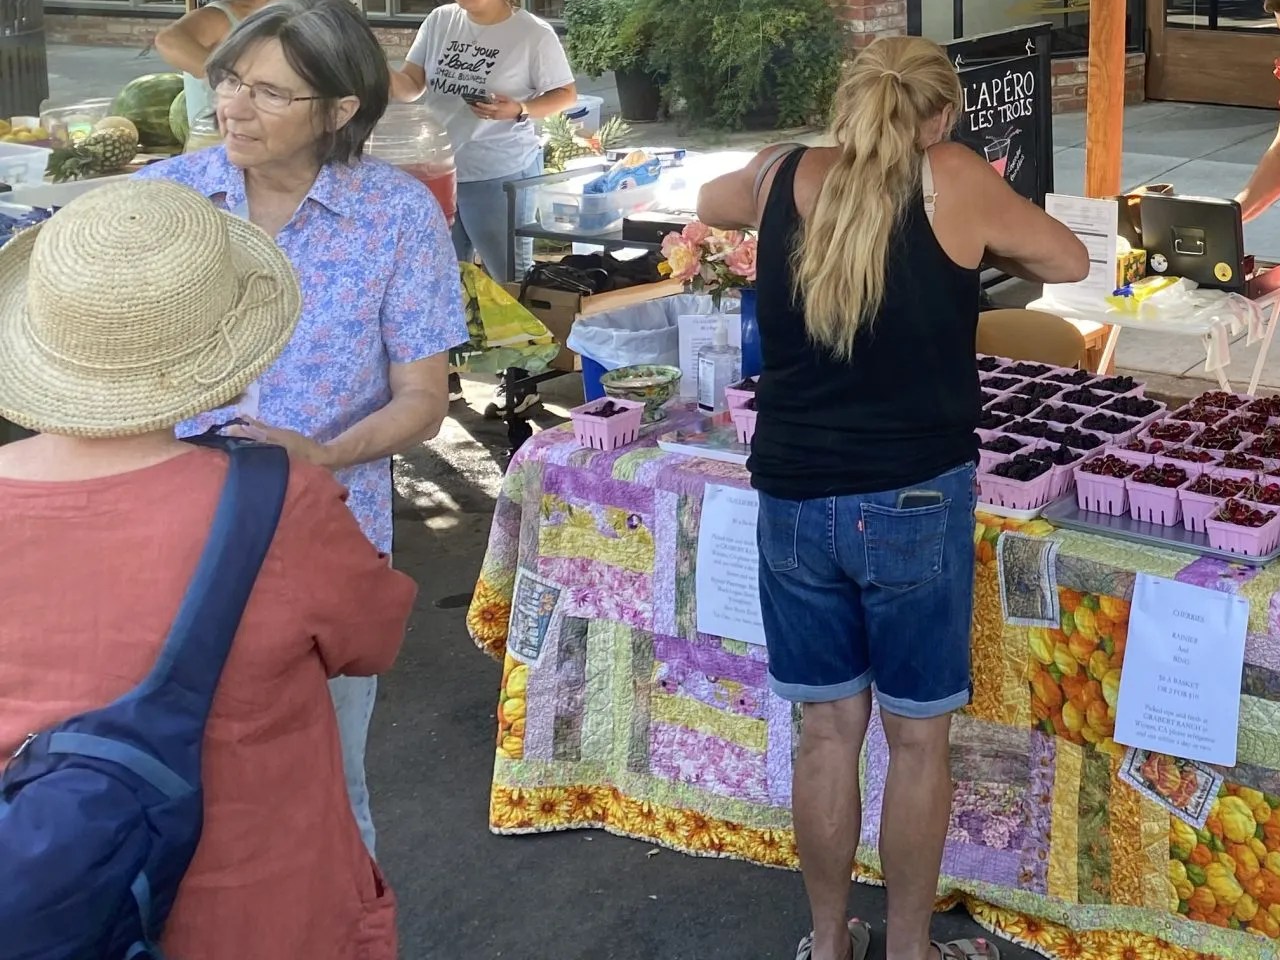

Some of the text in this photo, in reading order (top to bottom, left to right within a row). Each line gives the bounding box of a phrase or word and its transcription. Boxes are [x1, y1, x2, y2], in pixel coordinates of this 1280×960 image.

[446, 40, 500, 59] JUST YOUR
[445, 53, 486, 73] local
[434, 77, 478, 96] Mama
[963, 70, 1035, 112] L'APÉRO
[970, 98, 1034, 131] LES TROIS
